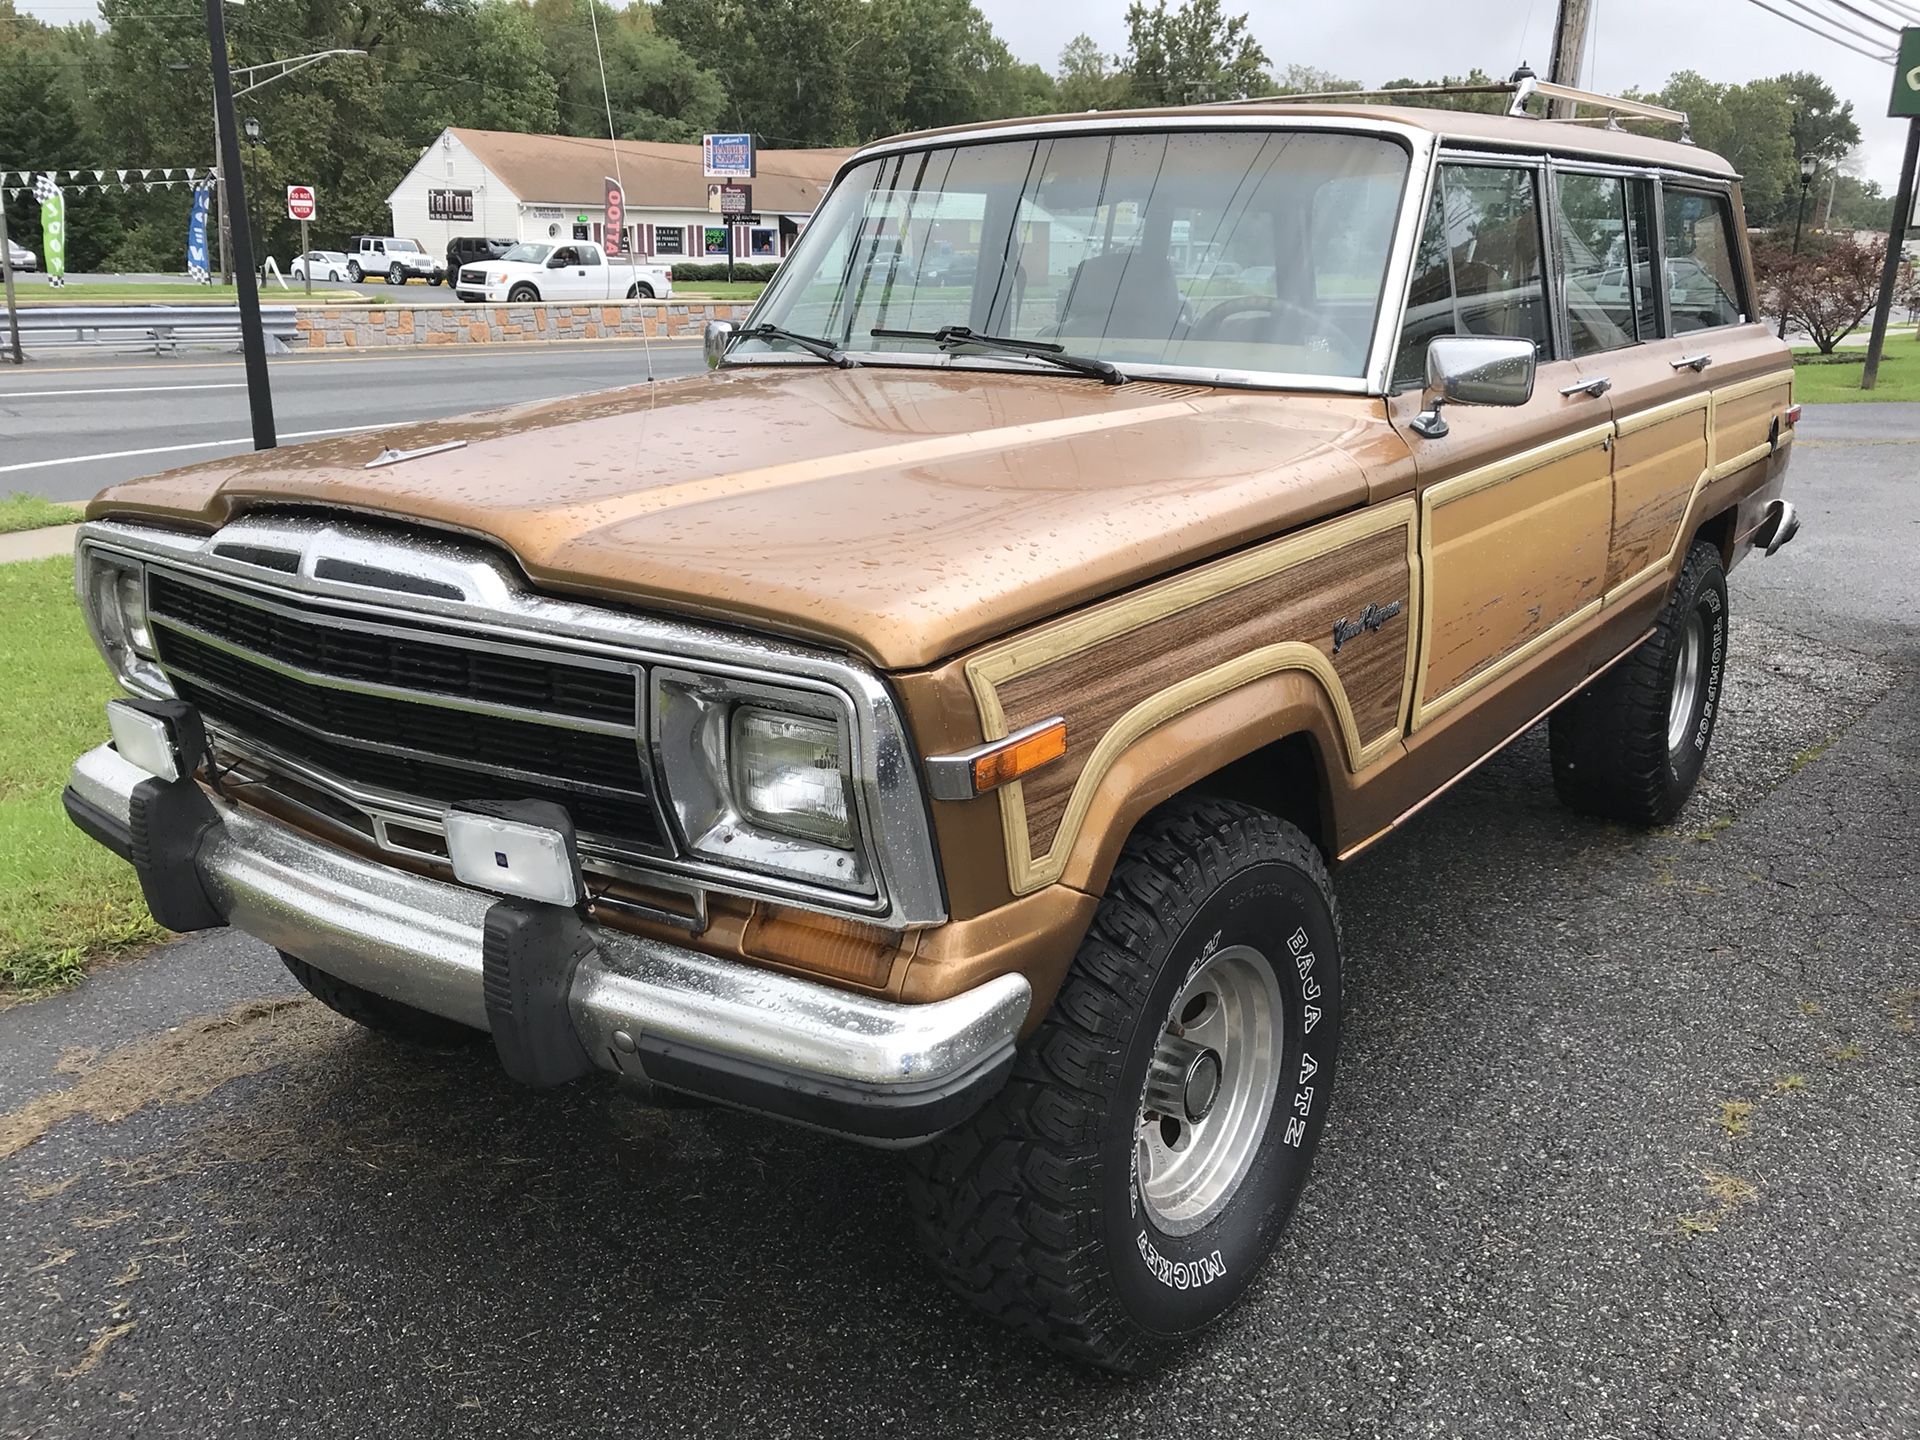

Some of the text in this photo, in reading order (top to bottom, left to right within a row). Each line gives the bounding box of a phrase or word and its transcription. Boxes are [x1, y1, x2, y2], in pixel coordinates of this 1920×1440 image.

[299, 192, 311, 200] NOT
[429, 190, 472, 212] tattoo
[293, 206, 311, 214] ENTER
[706, 236, 723, 244] SHOP
[1694, 616, 1723, 751] THOMPSON
[1284, 926, 1321, 1148] BAJA ATZ
[1136, 1229, 1227, 1290] MICKEY
